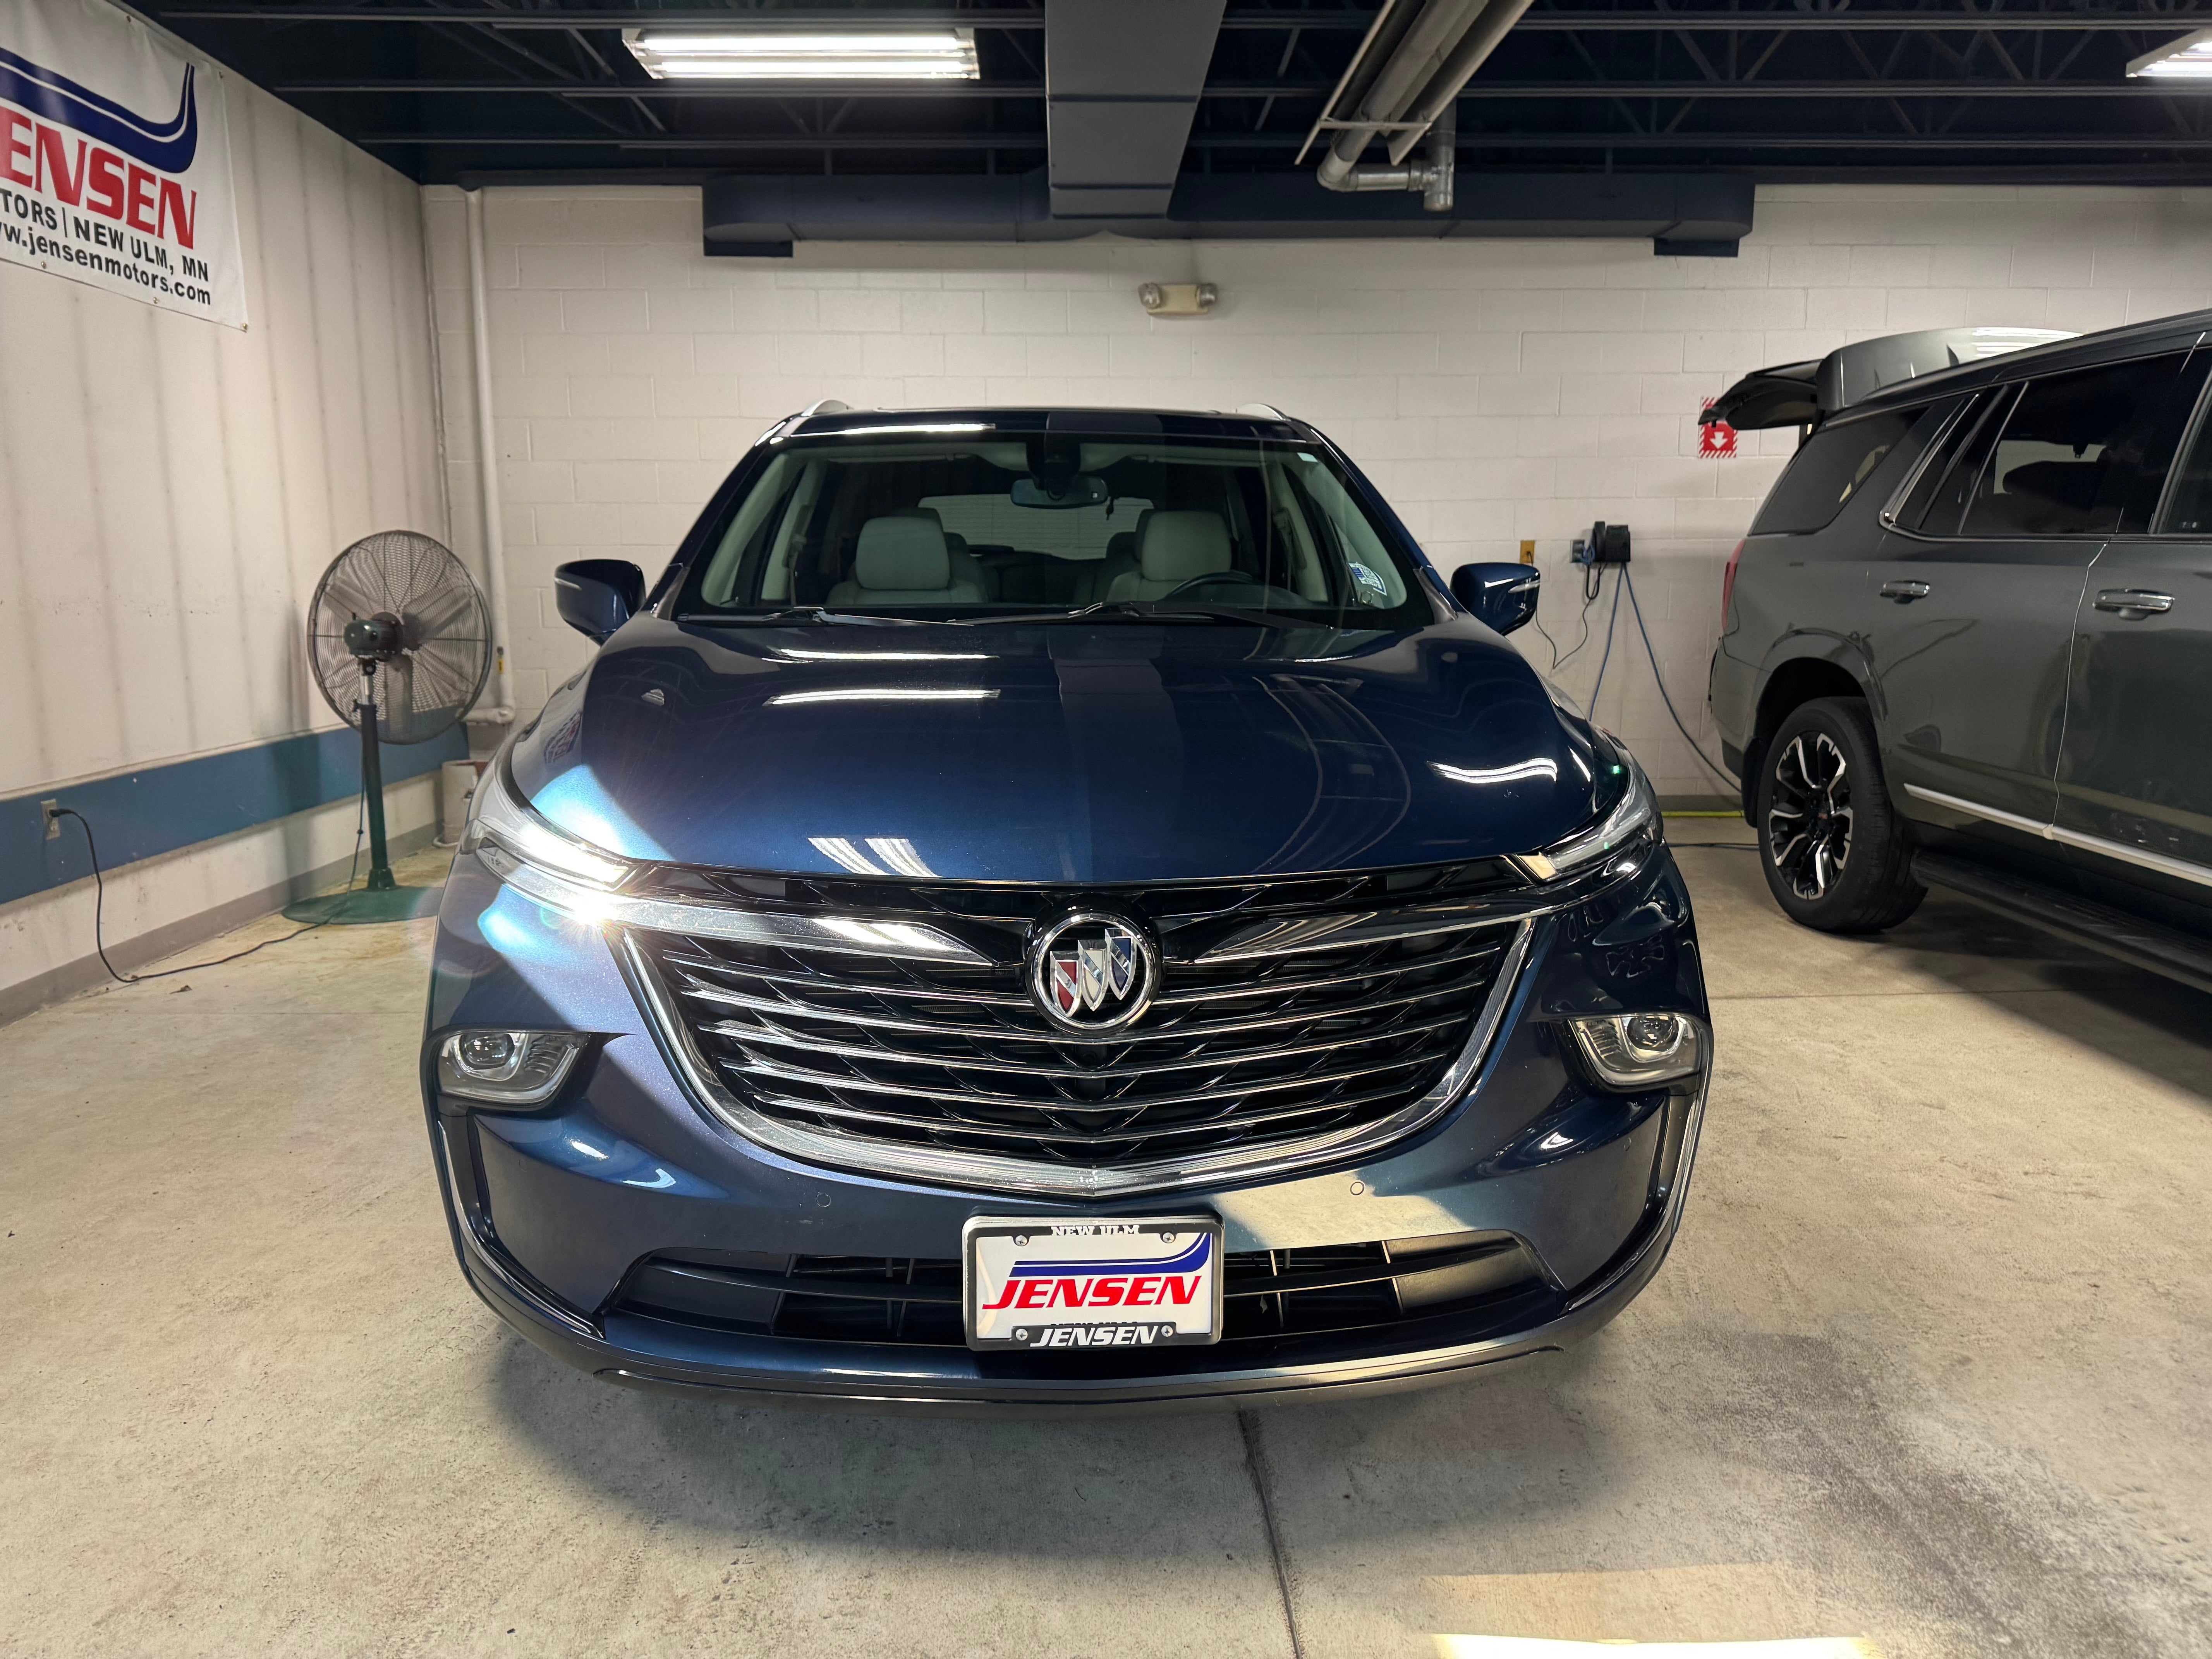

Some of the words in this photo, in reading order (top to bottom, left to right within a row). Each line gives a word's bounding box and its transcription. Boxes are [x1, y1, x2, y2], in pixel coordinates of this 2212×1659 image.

[0, 222, 210, 305] w.jensenmotors.com
[73, 216, 124, 252] NEW
[131, 235, 173, 276] ULM,
[182, 254, 208, 282] MN
[1051, 1225, 1095, 1236] NEW
[1099, 1224, 1140, 1235] ULM
[982, 1276, 1202, 1310] JENSEN
[1030, 1326, 1159, 1347] JENSEN
